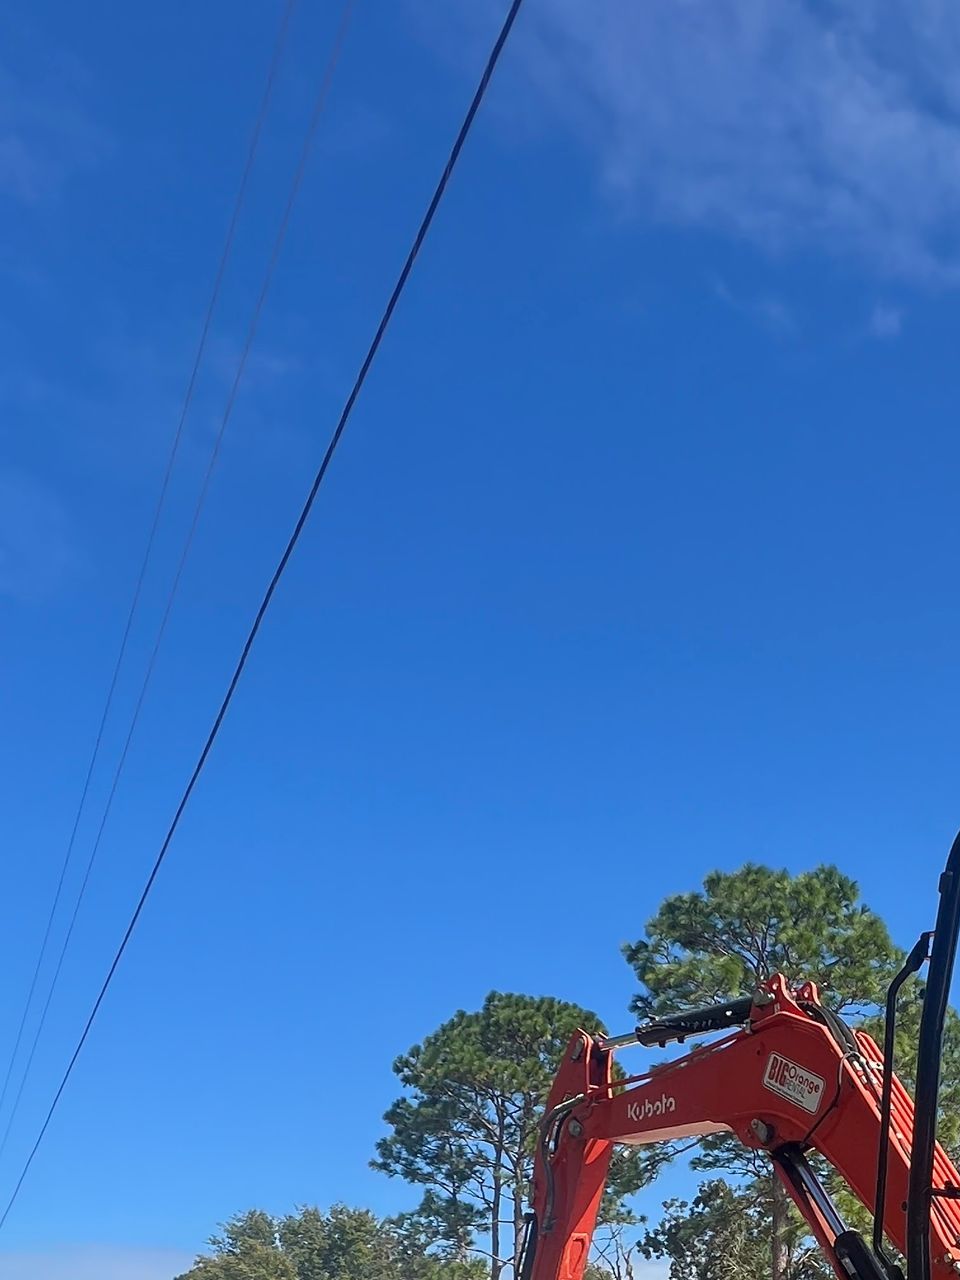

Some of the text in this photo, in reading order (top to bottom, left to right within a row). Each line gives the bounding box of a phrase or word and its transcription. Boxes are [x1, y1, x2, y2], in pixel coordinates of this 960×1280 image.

[768, 1056, 789, 1087] BIG
[789, 1066, 820, 1094] Orange
[627, 1093, 676, 1121] Kubota
